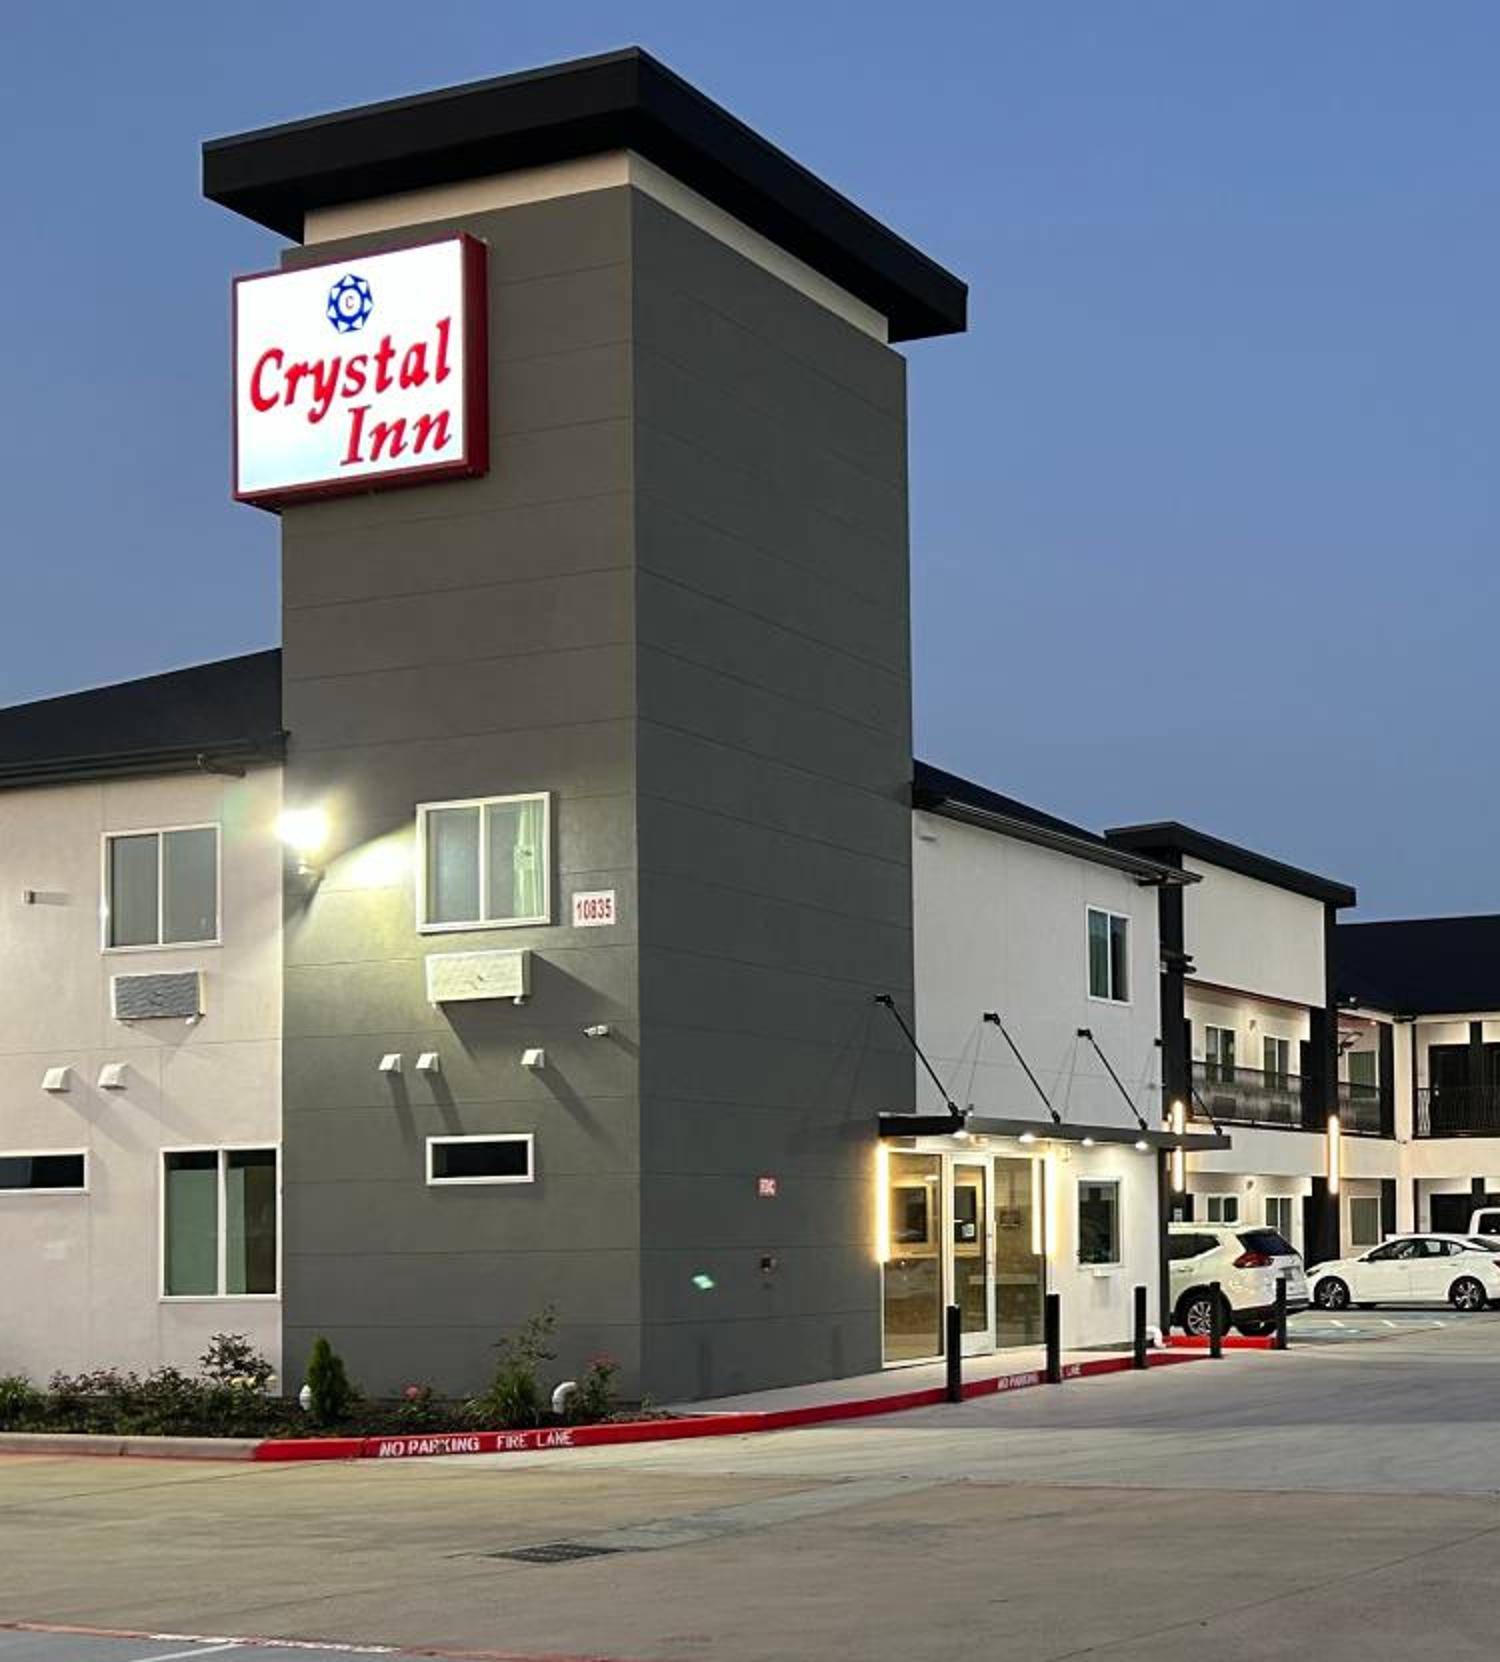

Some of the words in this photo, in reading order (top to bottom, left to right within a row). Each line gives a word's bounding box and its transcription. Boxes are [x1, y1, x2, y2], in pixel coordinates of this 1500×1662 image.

[344, 295, 355, 310] C
[249, 317, 452, 424] Crystal
[340, 404, 452, 466] Inn
[576, 898, 612, 920] 10835
[379, 1441, 405, 1457] NO
[408, 1437, 480, 1455] PARKING
[497, 1432, 528, 1450] FIRE
[536, 1429, 575, 1447] LANE
